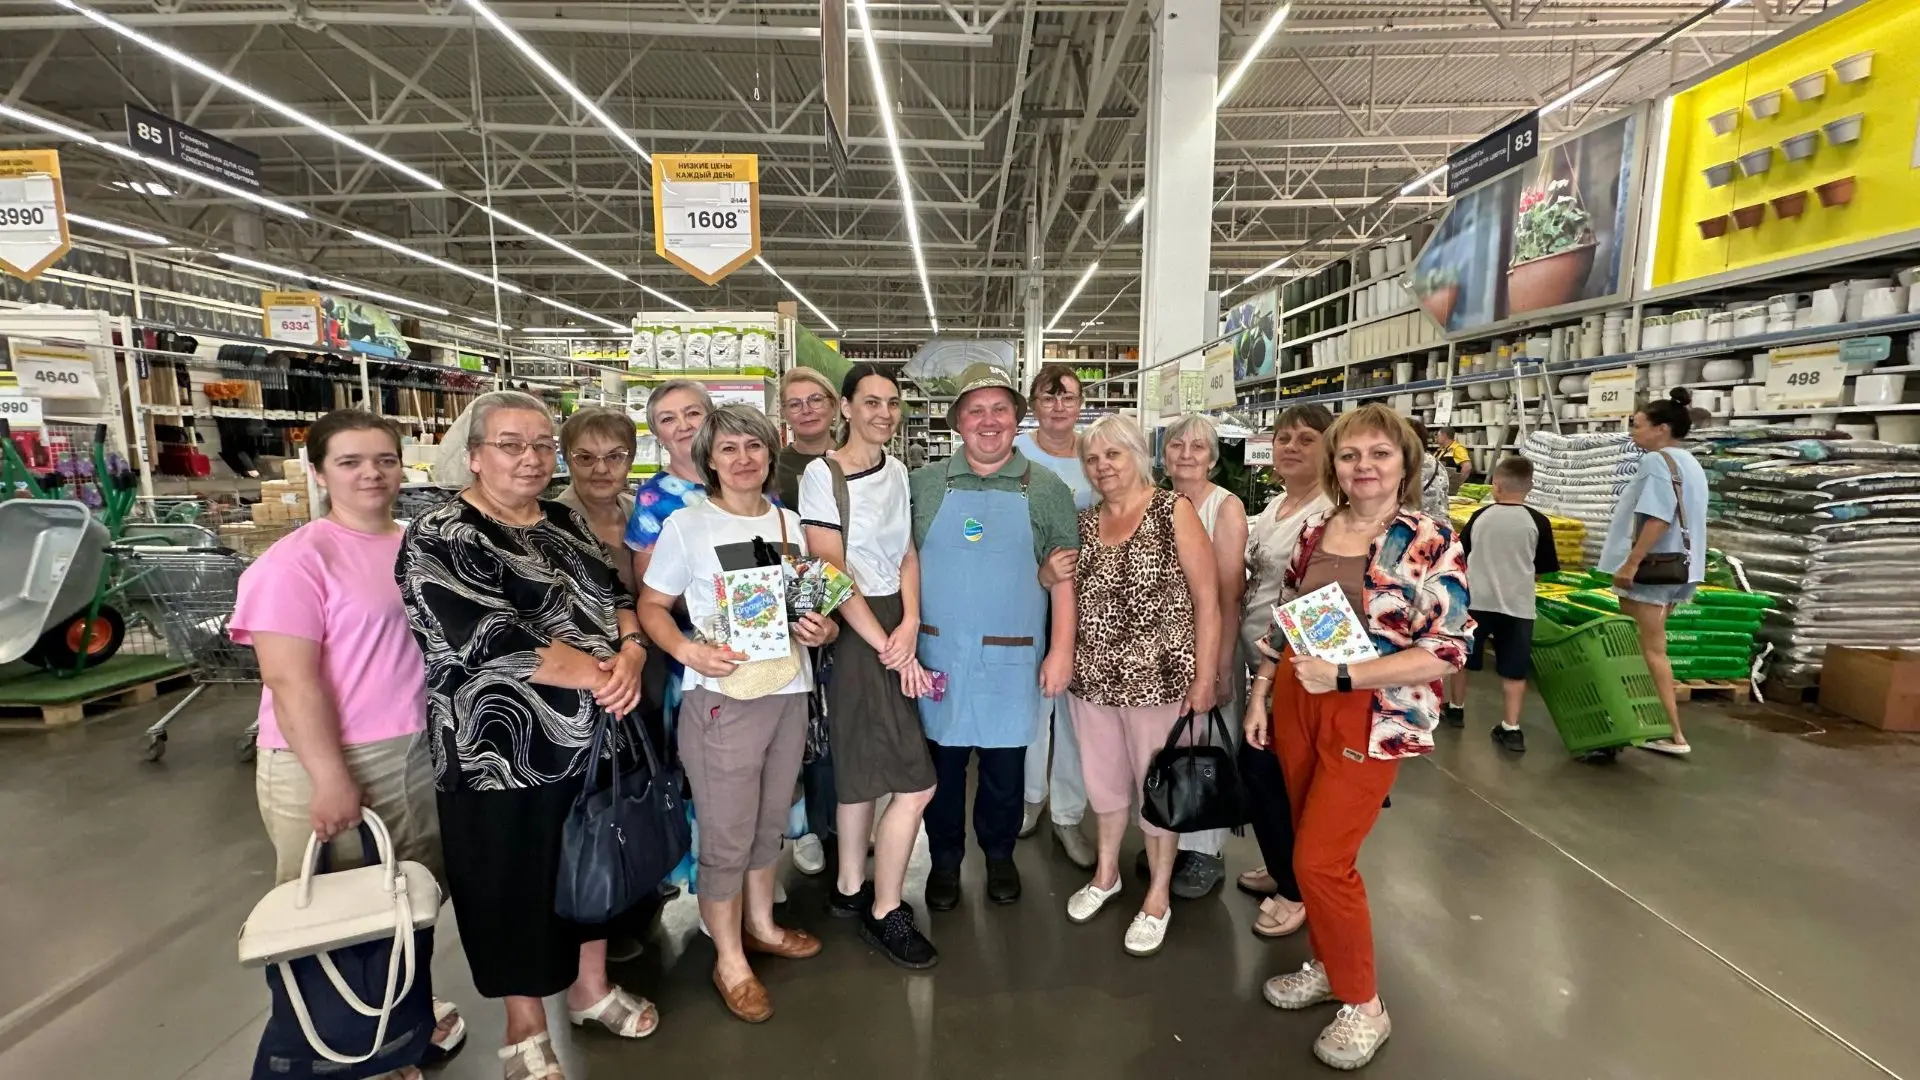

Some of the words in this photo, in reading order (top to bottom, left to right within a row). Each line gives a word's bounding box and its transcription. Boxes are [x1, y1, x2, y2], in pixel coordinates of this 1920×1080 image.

[137, 122, 162, 144] 85
[179, 131, 209, 149] Семена
[1515, 130, 1532, 151] 83
[180, 142, 222, 163] Удобрения
[222, 158, 237, 170] для
[237, 163, 255, 176] сада
[678, 162, 709, 170] НИЗКИЕ
[710, 162, 732, 170] ЦЕНЫ
[675, 170, 712, 179] КАЖДЫЙ
[687, 210, 738, 229] 1608
[281, 320, 310, 331] 6334
[34, 369, 80, 385] 4640
[1786, 370, 1821, 386] 498
[1601, 390, 1619, 402] 621
[0, 401, 29, 413] 990
[1251, 451, 1271, 460] 8890
